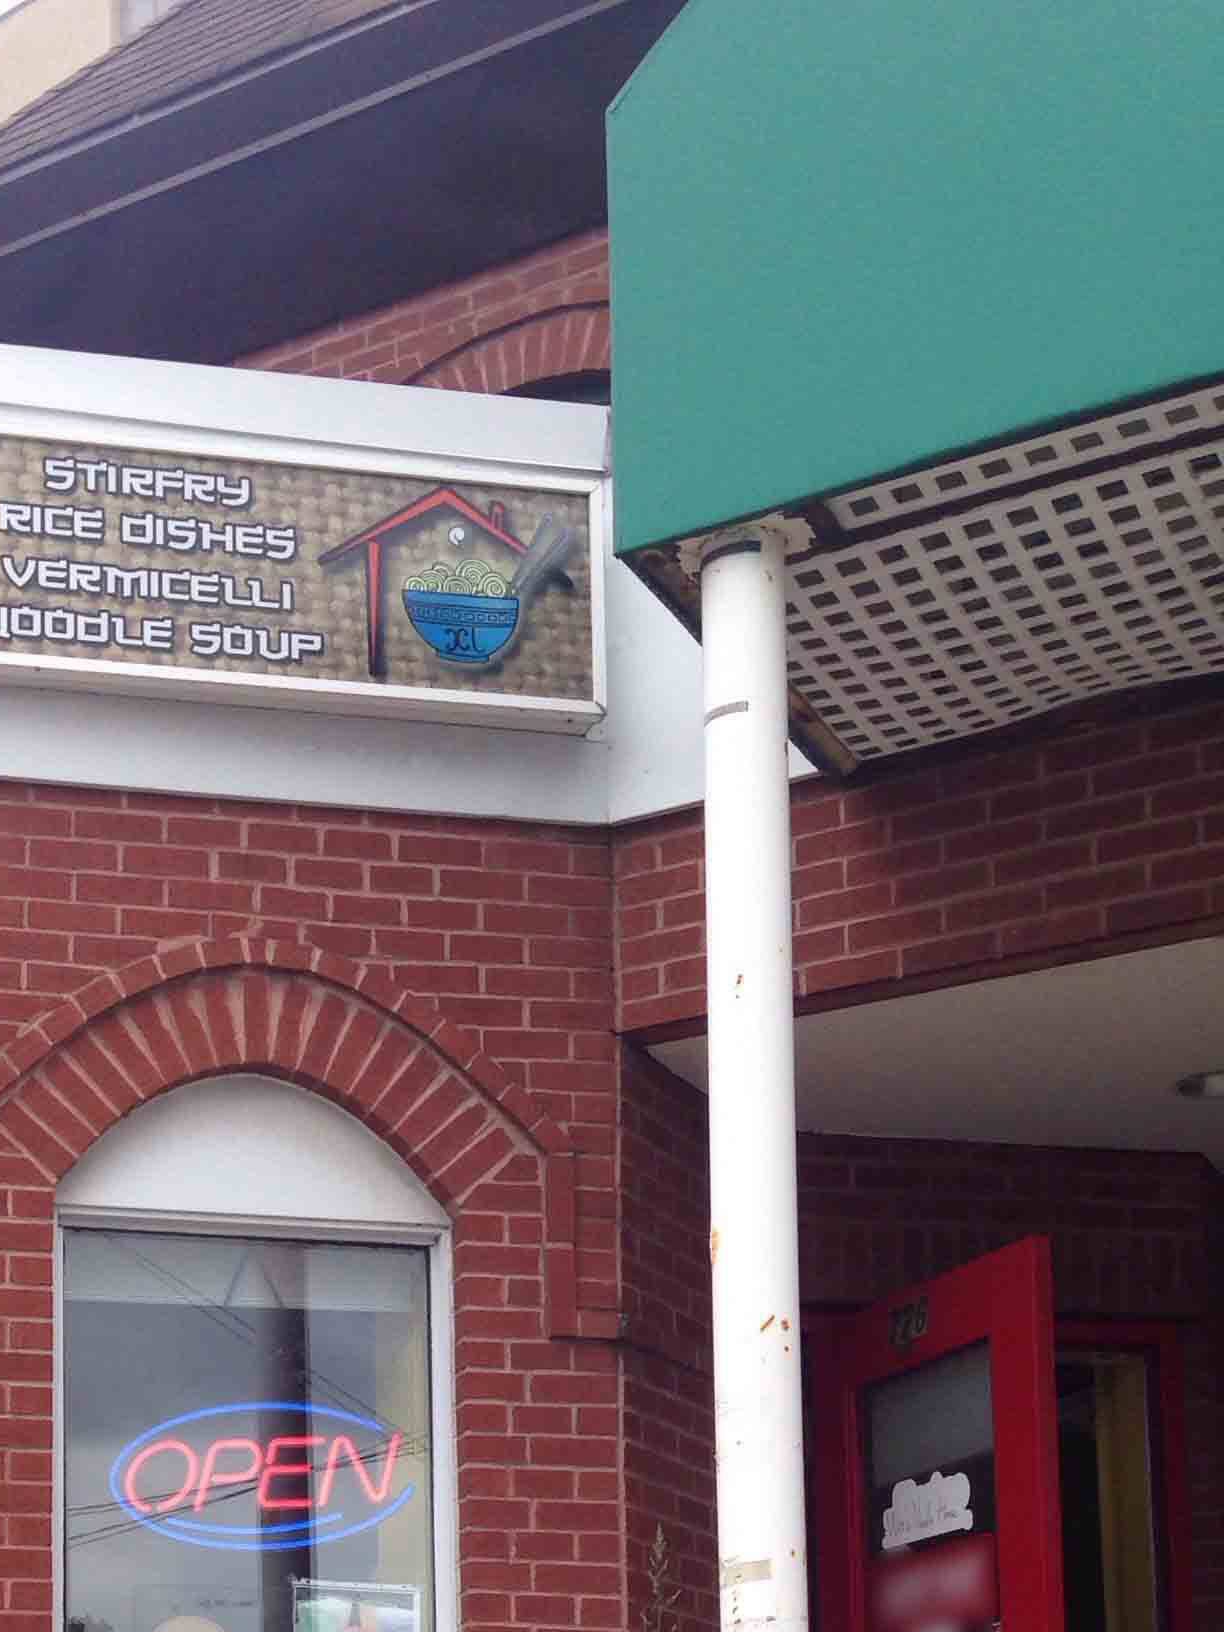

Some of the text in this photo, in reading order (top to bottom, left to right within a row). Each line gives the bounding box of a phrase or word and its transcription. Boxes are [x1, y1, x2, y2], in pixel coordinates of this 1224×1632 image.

[43, 457, 251, 506] STIRFRY
[120, 513, 296, 559] DISHES
[2, 556, 293, 610] VERMICELLI
[192, 625, 323, 661] SOUP
[124, 1430, 404, 1513] OPEN
